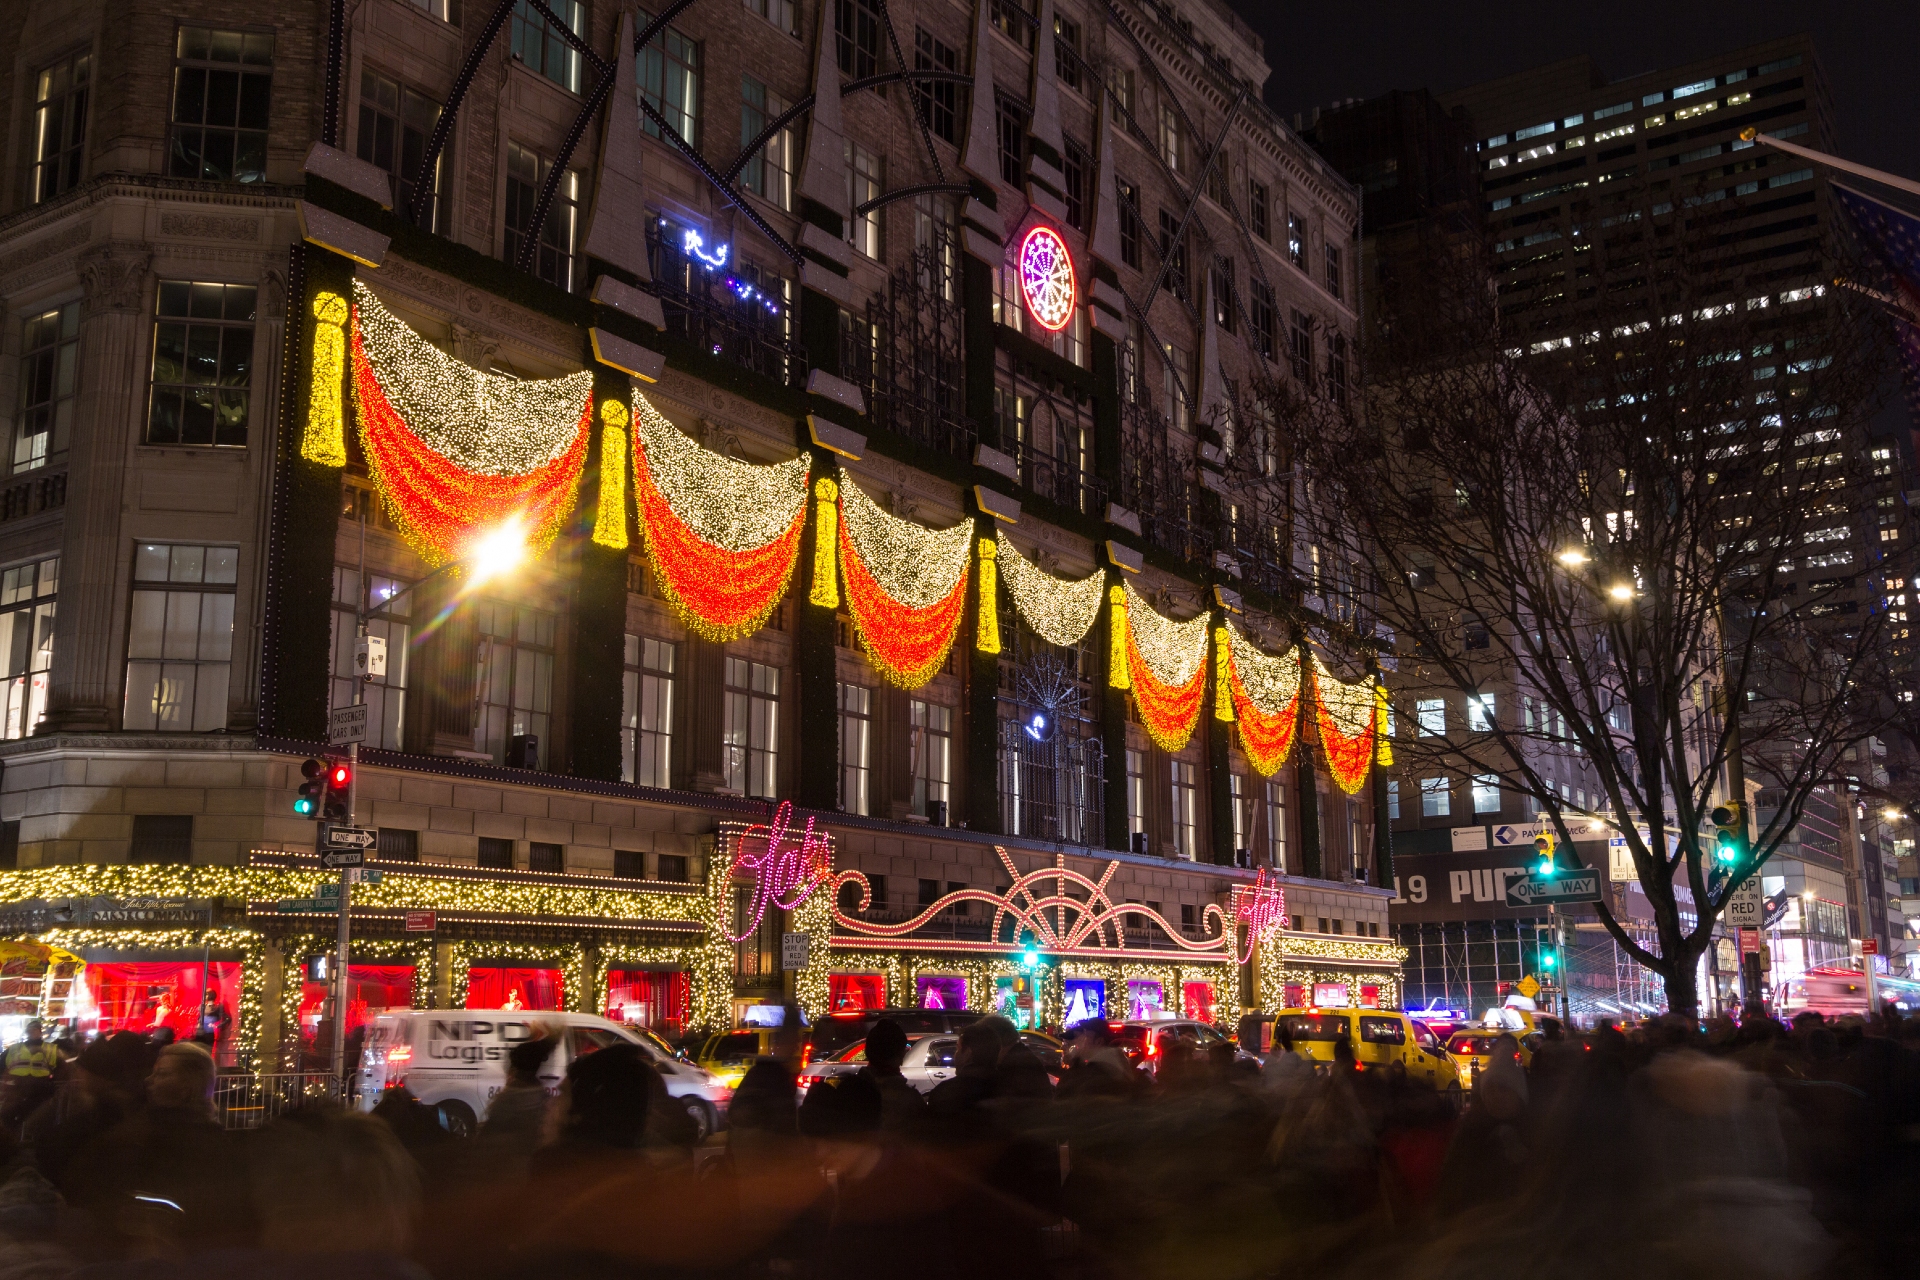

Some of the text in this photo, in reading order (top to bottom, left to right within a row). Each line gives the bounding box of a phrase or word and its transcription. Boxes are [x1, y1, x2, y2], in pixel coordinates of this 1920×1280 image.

[334, 710, 365, 724] PASSENGER
[333, 724, 364, 739] CARS ONLY
[335, 832, 370, 843] ONE WAY
[327, 854, 358, 863] ONE WAY
[363, 870, 369, 882] 5
[330, 884, 338, 892] 50
[1518, 879, 1592, 897] ONE WAY
[1732, 903, 1755, 914] RED
[785, 935, 807, 944] STOP
[428, 1020, 532, 1043] NPD
